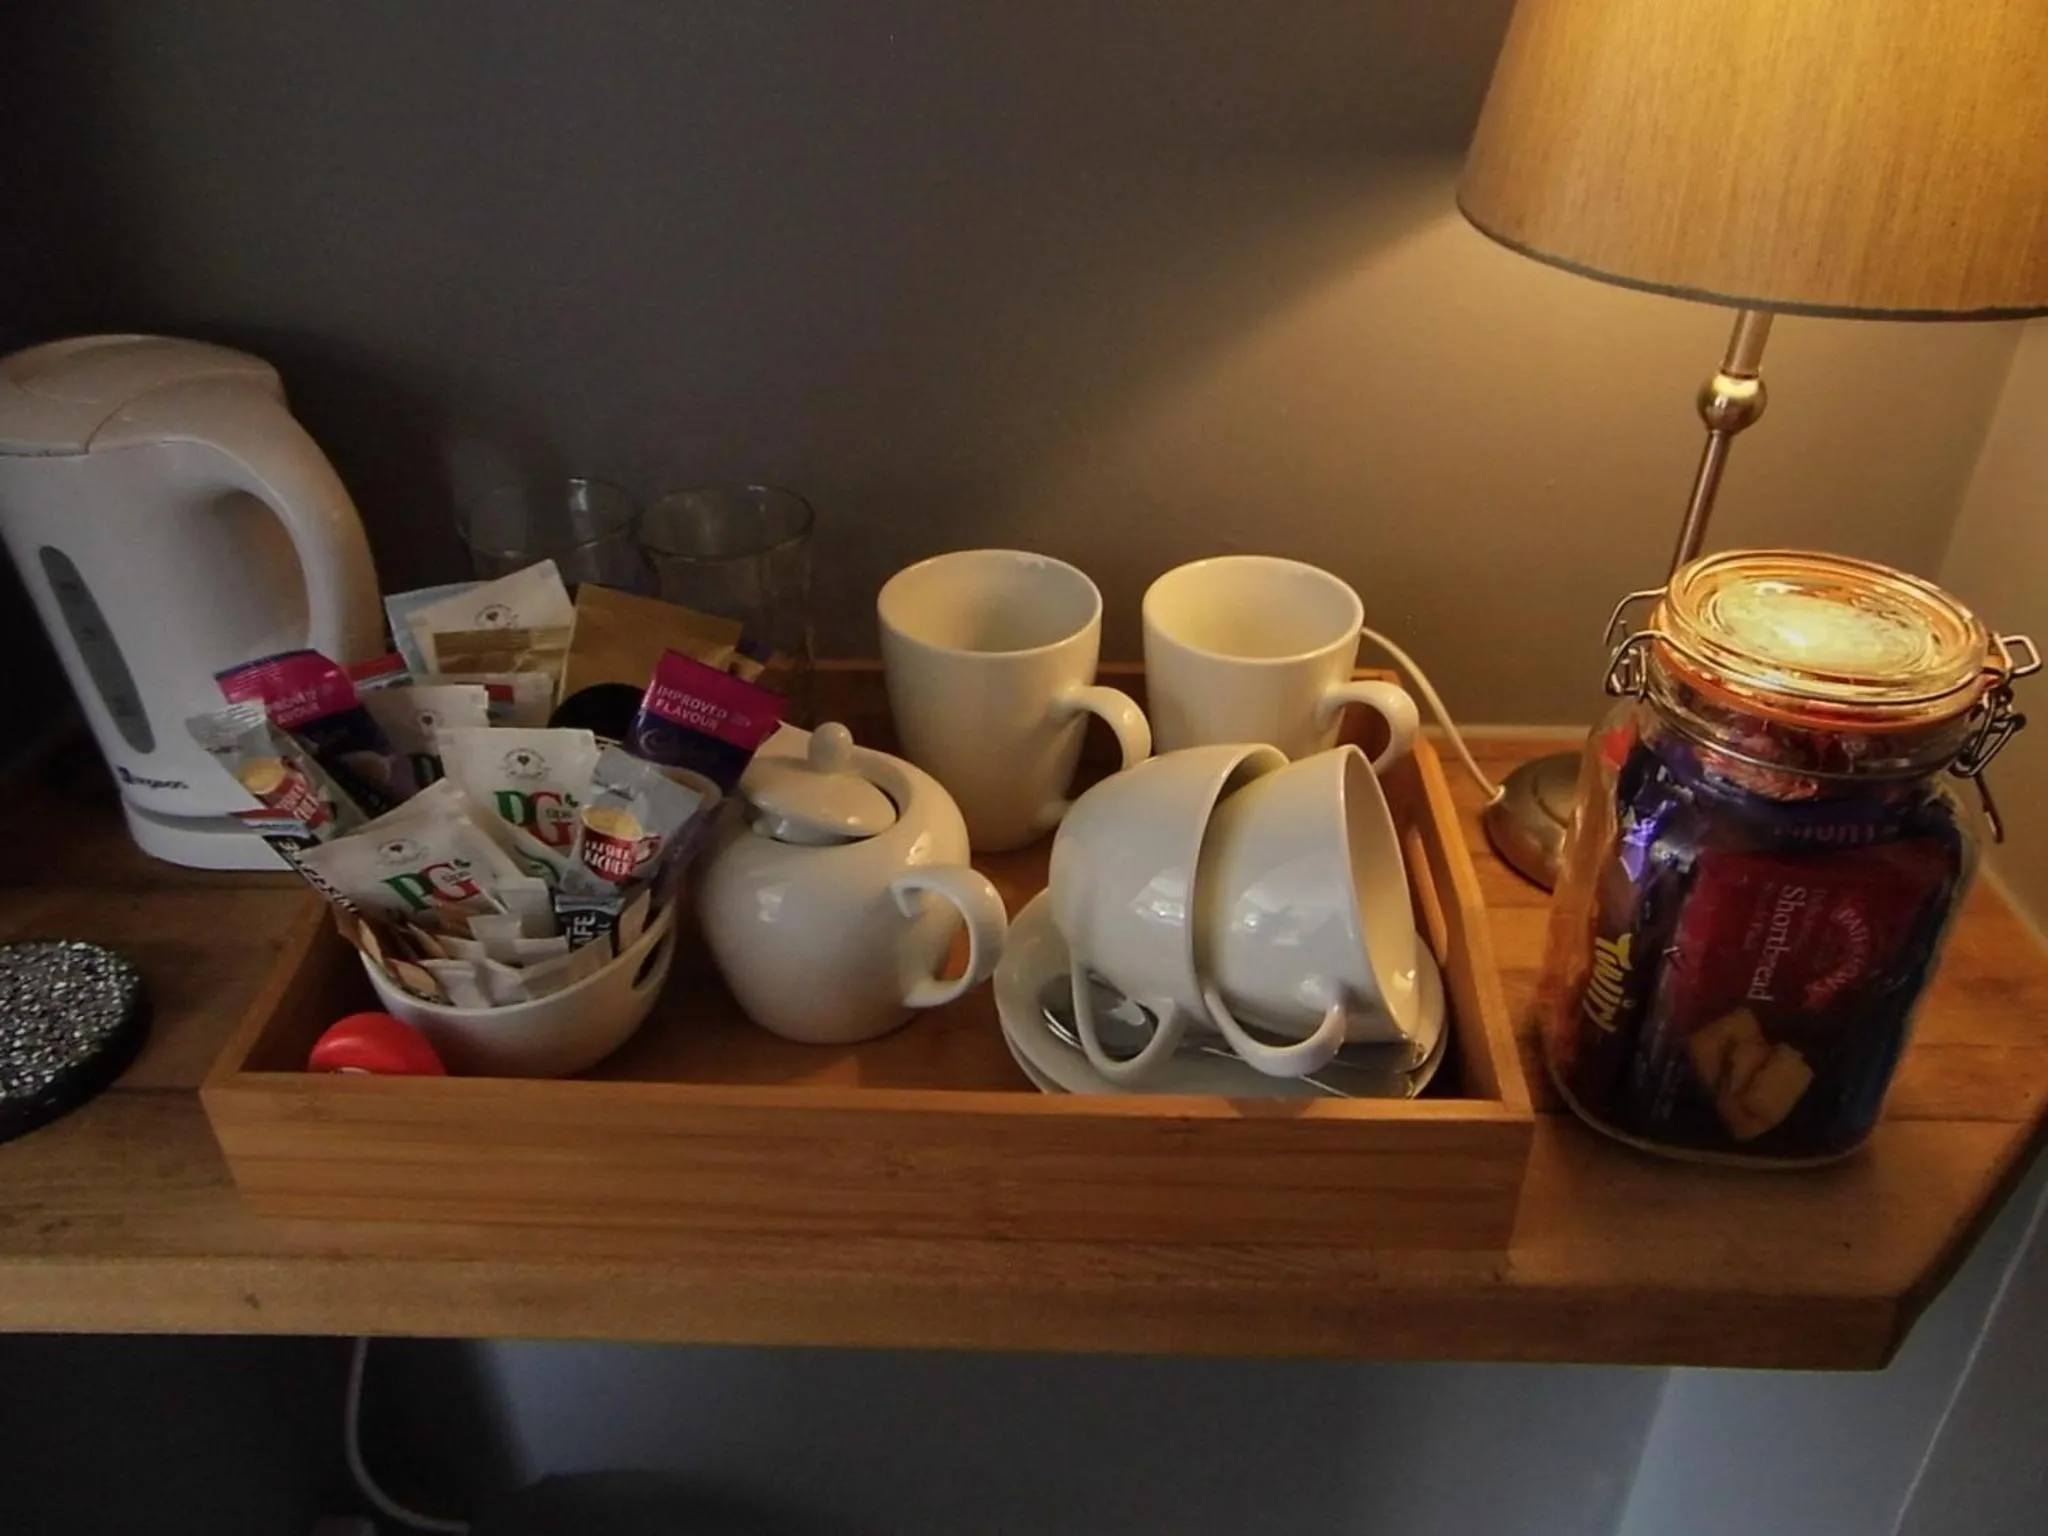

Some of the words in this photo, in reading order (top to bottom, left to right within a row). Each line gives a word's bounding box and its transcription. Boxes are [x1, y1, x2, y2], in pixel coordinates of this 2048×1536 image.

[655, 699, 718, 731] FLAVOUR
[656, 685, 728, 719] IMPROVED
[382, 862, 480, 911] PG
[1747, 884, 1807, 1000] Shortbread
